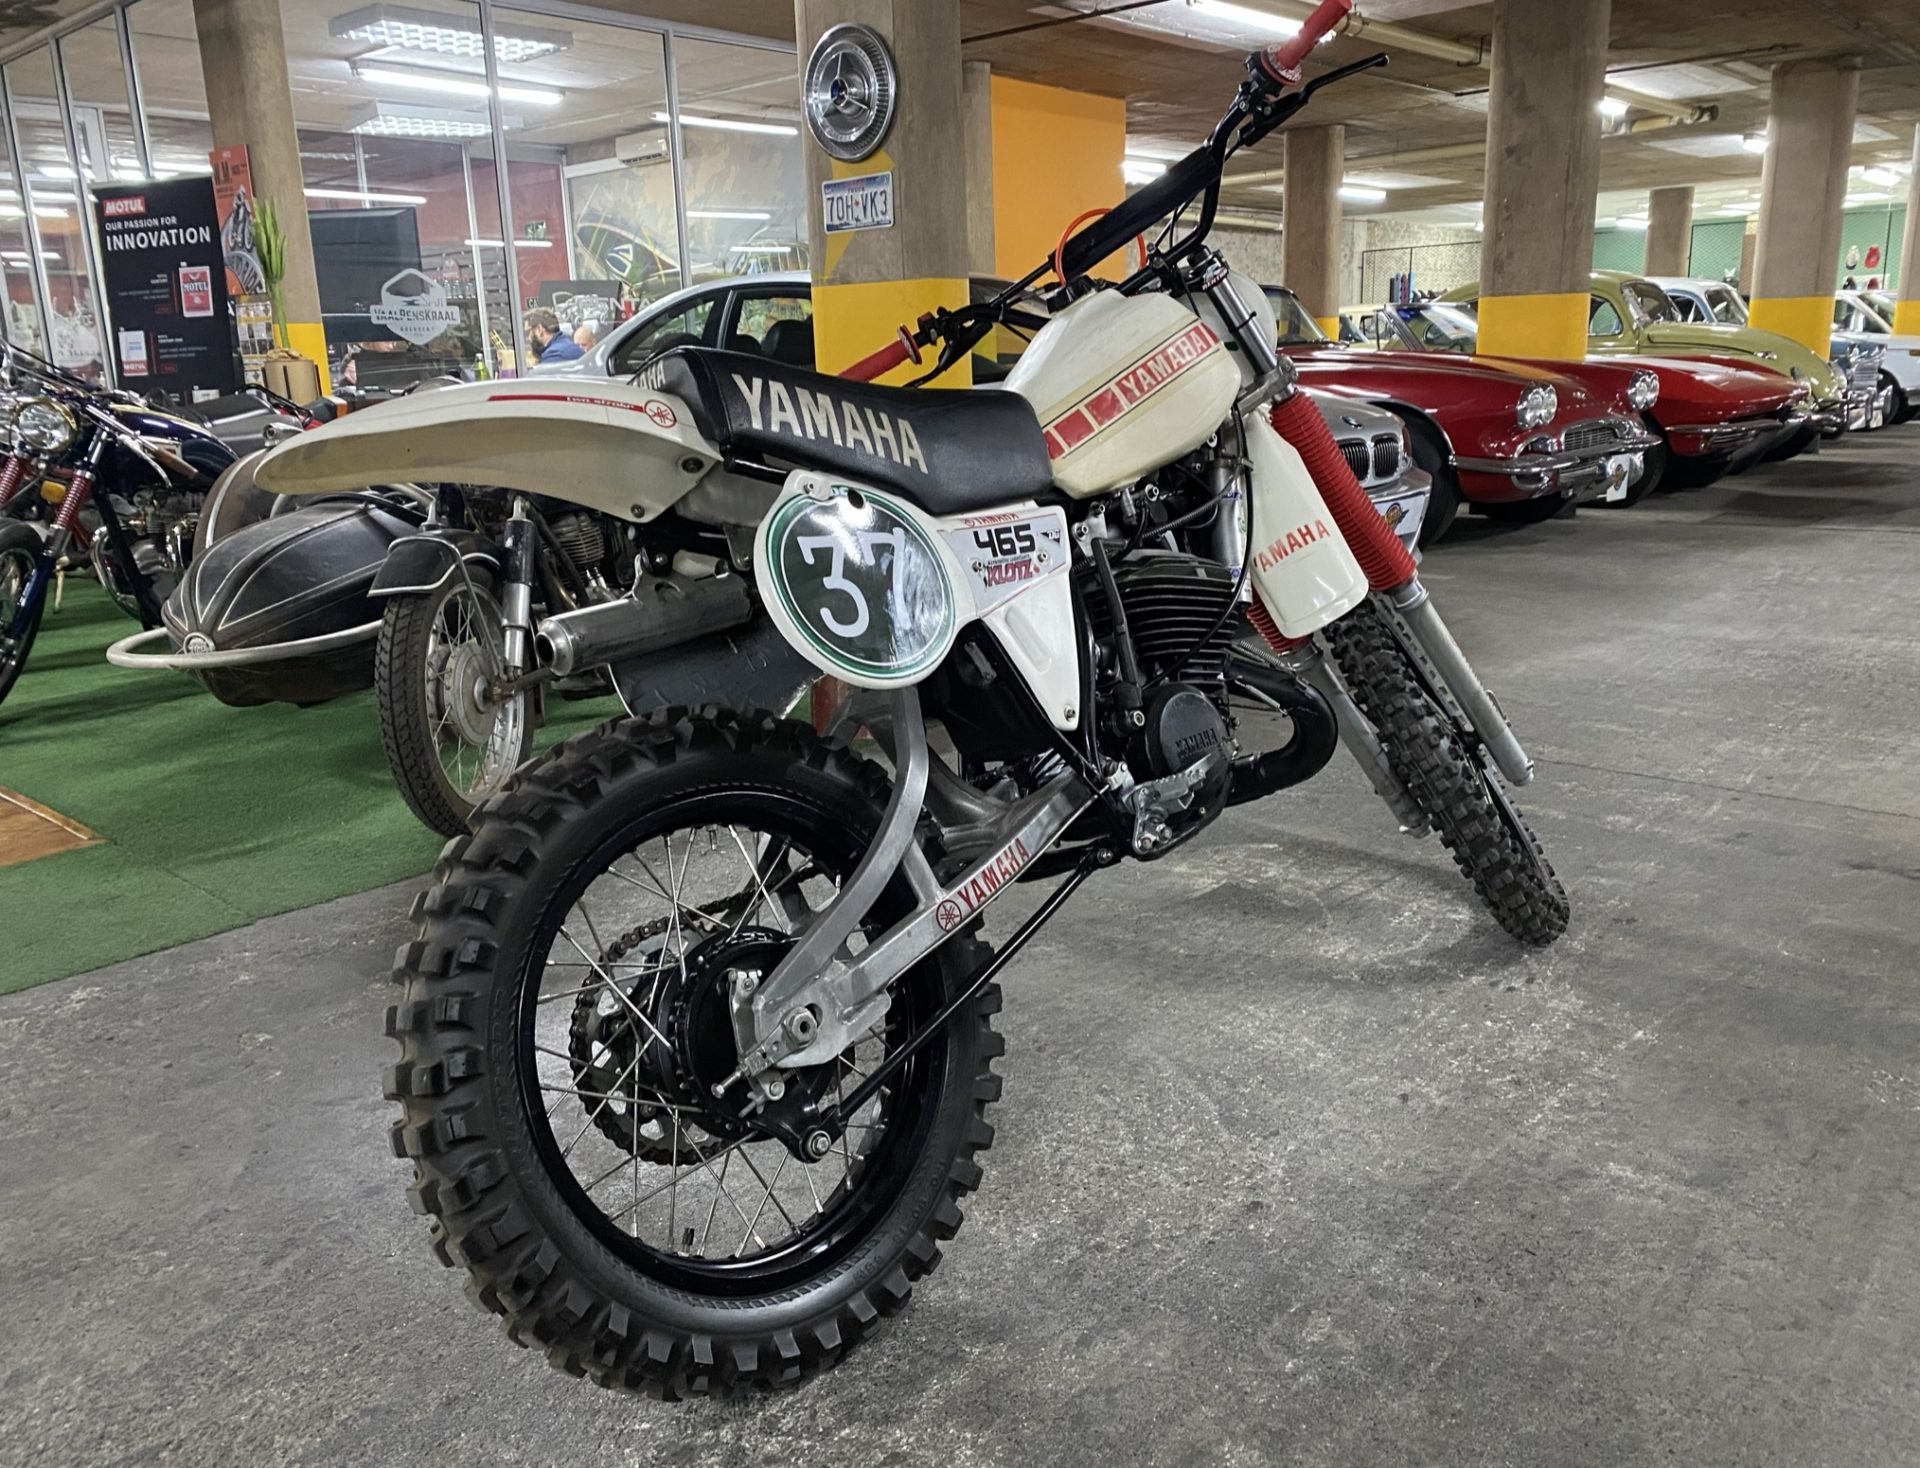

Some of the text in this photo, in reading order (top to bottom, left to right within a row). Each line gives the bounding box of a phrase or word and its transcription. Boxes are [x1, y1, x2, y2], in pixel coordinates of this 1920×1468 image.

[104, 199, 145, 214] MOTUL
[105, 215, 178, 231] OUR PASSION FOR
[106, 226, 211, 251] INNOVATION
[182, 281, 209, 293] MOTUL
[1122, 329, 1208, 398] YAMAHA
[731, 373, 929, 475] YAMAHA
[973, 523, 1036, 558] 465
[797, 527, 912, 638] 37
[986, 559, 1033, 587] KLOTZ
[957, 837, 1030, 913] YAMAHA
